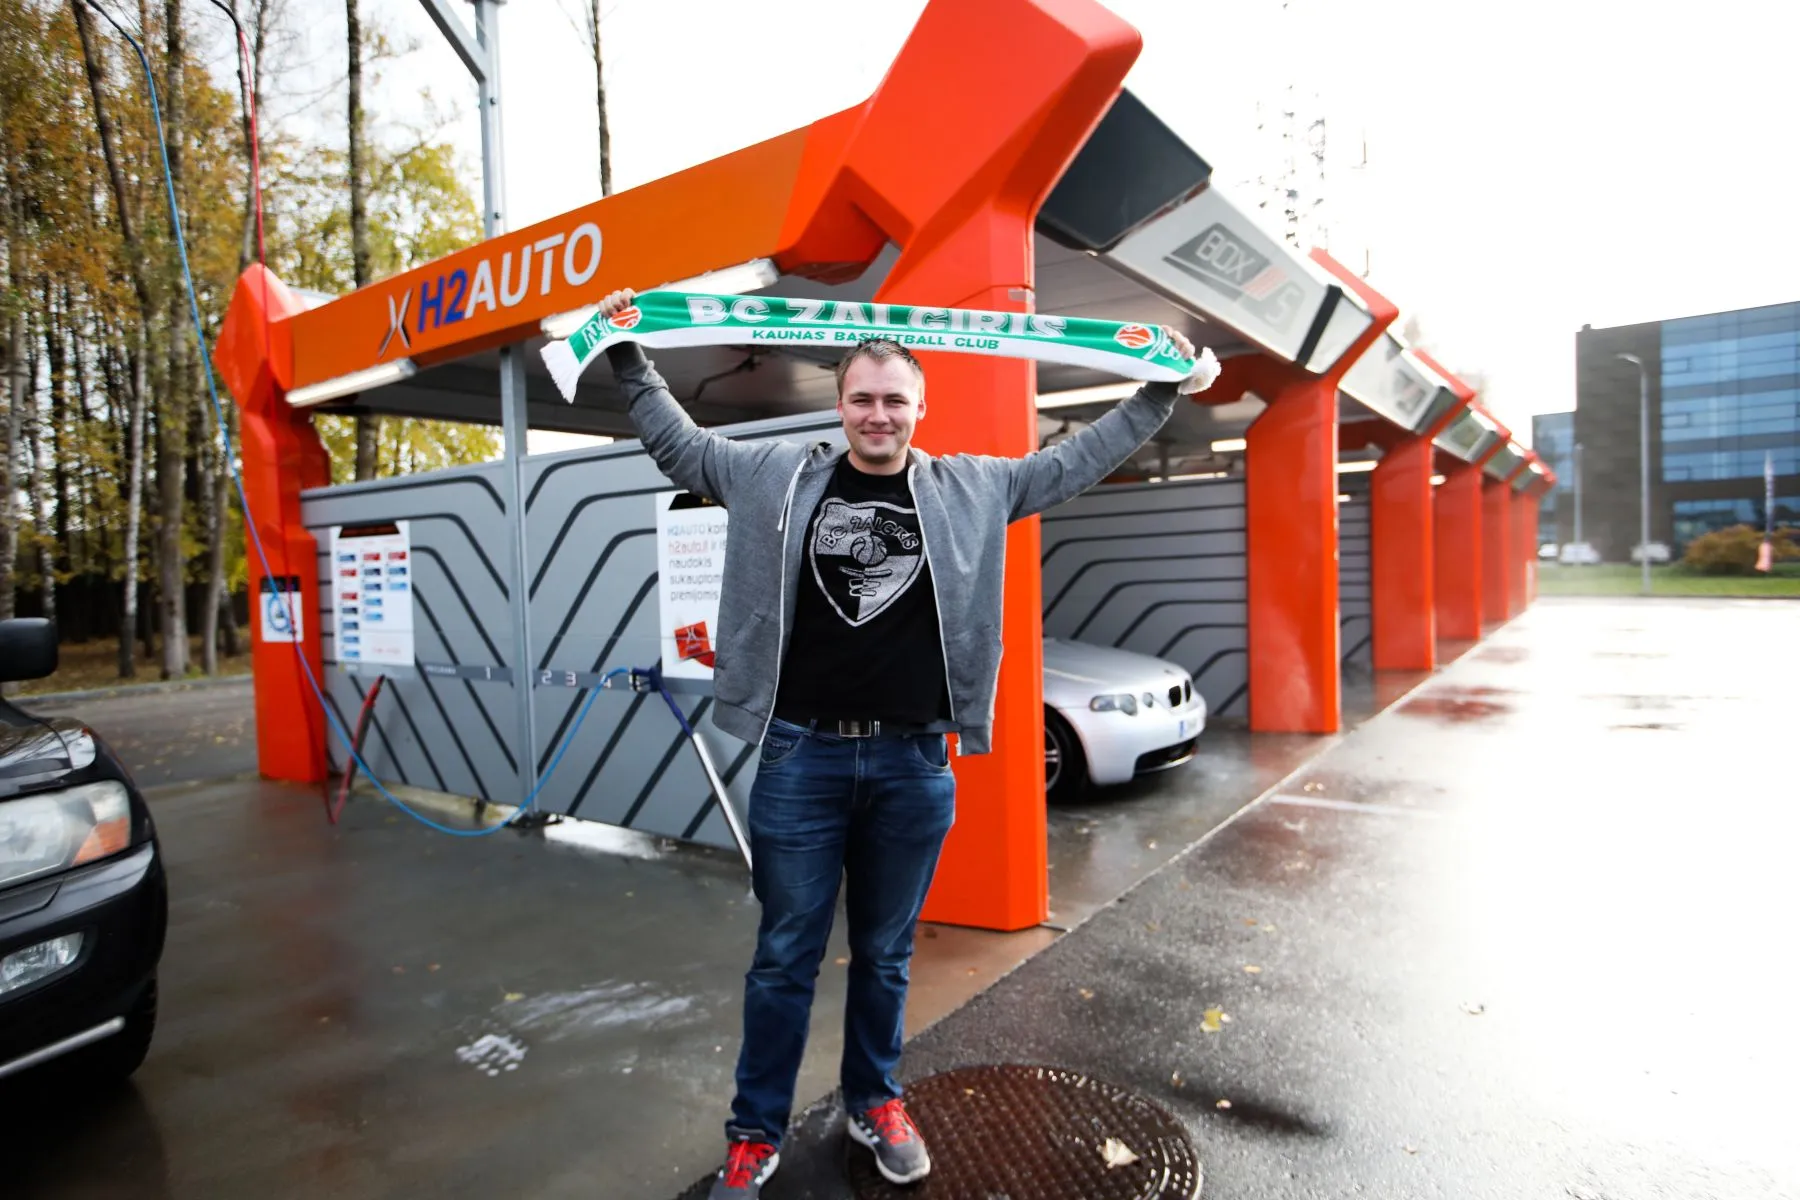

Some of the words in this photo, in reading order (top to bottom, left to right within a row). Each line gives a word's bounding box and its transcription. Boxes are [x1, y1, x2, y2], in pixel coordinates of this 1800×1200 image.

[1195, 229, 1257, 283] BOX
[417, 222, 603, 333] H2AUTO
[686, 296, 771, 325] BC
[752, 329, 826, 341] KAUNAS
[833, 331, 947, 346] BASKETBALL
[954, 336, 1000, 350] CLUB
[820, 526, 848, 549] BC
[669, 573, 722, 585] sukauptom
[541, 670, 552, 685] 2
[565, 671, 576, 686] 3
